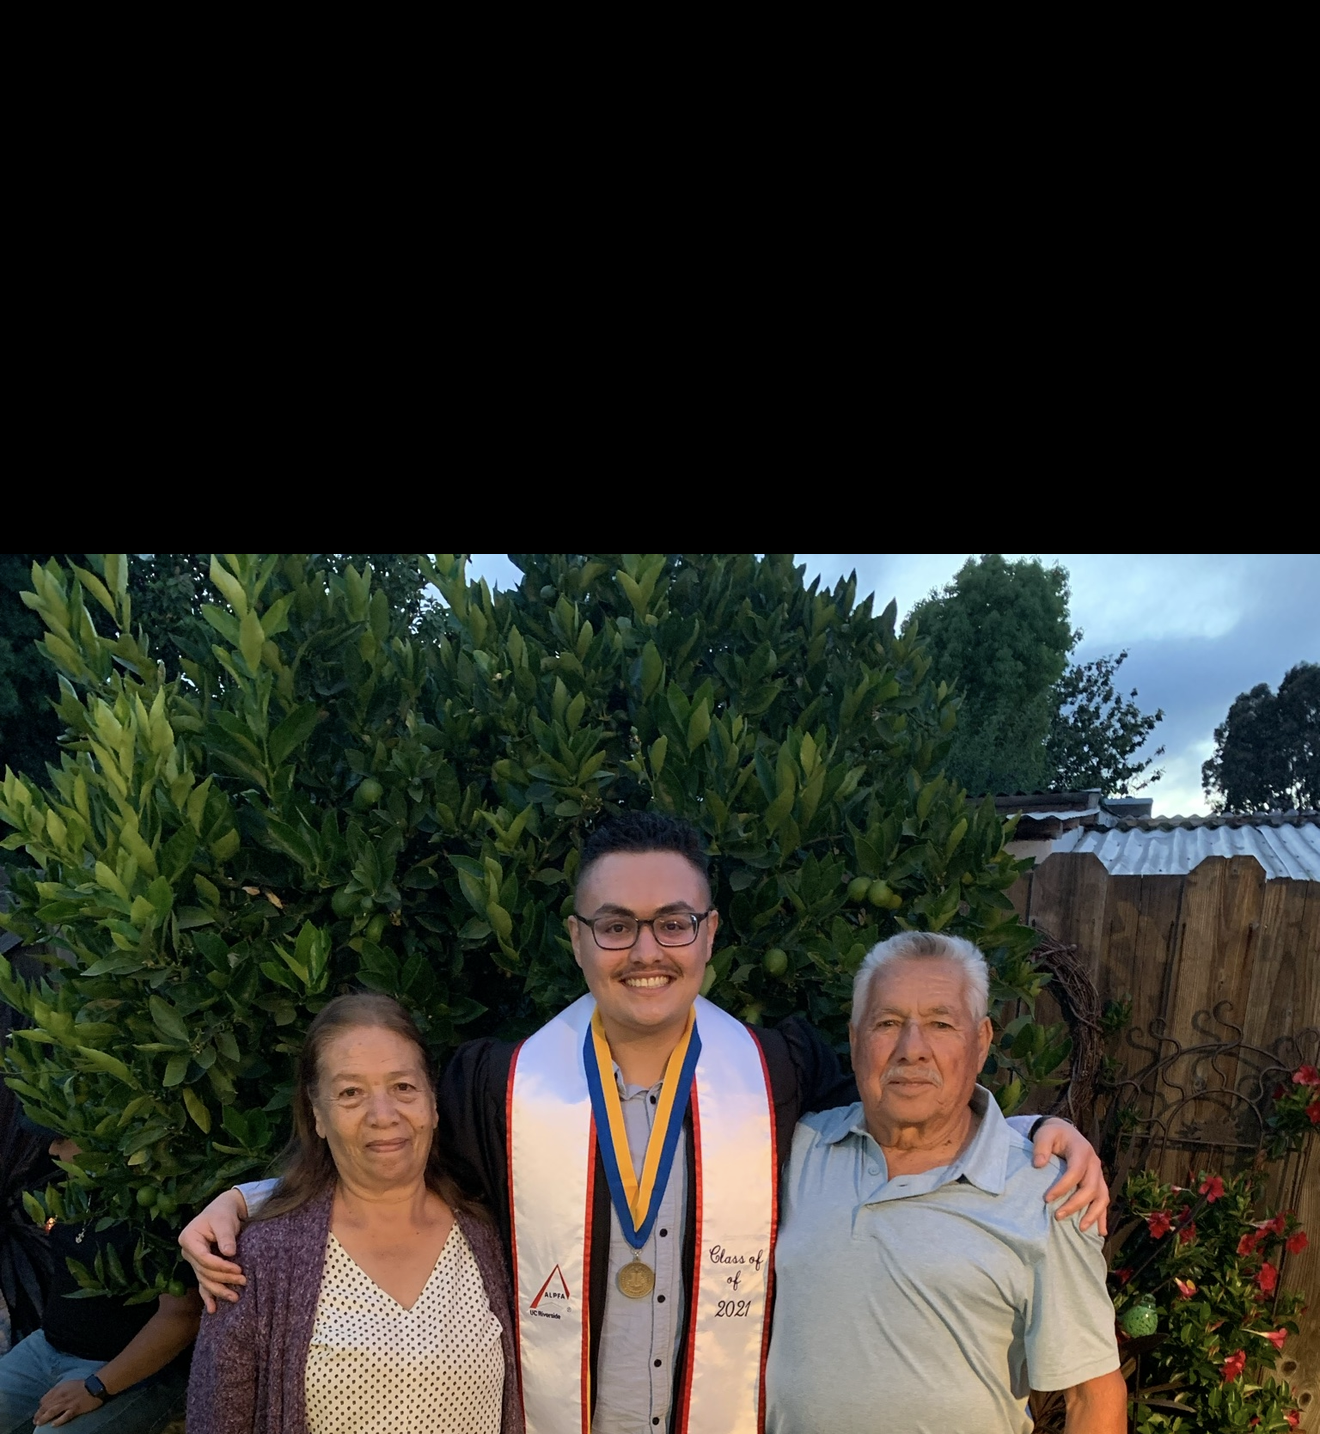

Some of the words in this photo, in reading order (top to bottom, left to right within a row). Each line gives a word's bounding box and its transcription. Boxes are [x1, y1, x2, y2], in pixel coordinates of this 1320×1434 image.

[709, 1244, 745, 1264] Class
[749, 1249, 764, 1271] of
[726, 1270, 741, 1291] of
[544, 1291, 566, 1300] ALPFA
[538, 1310, 562, 1320] Riverside
[714, 1300, 751, 1317] 2021
